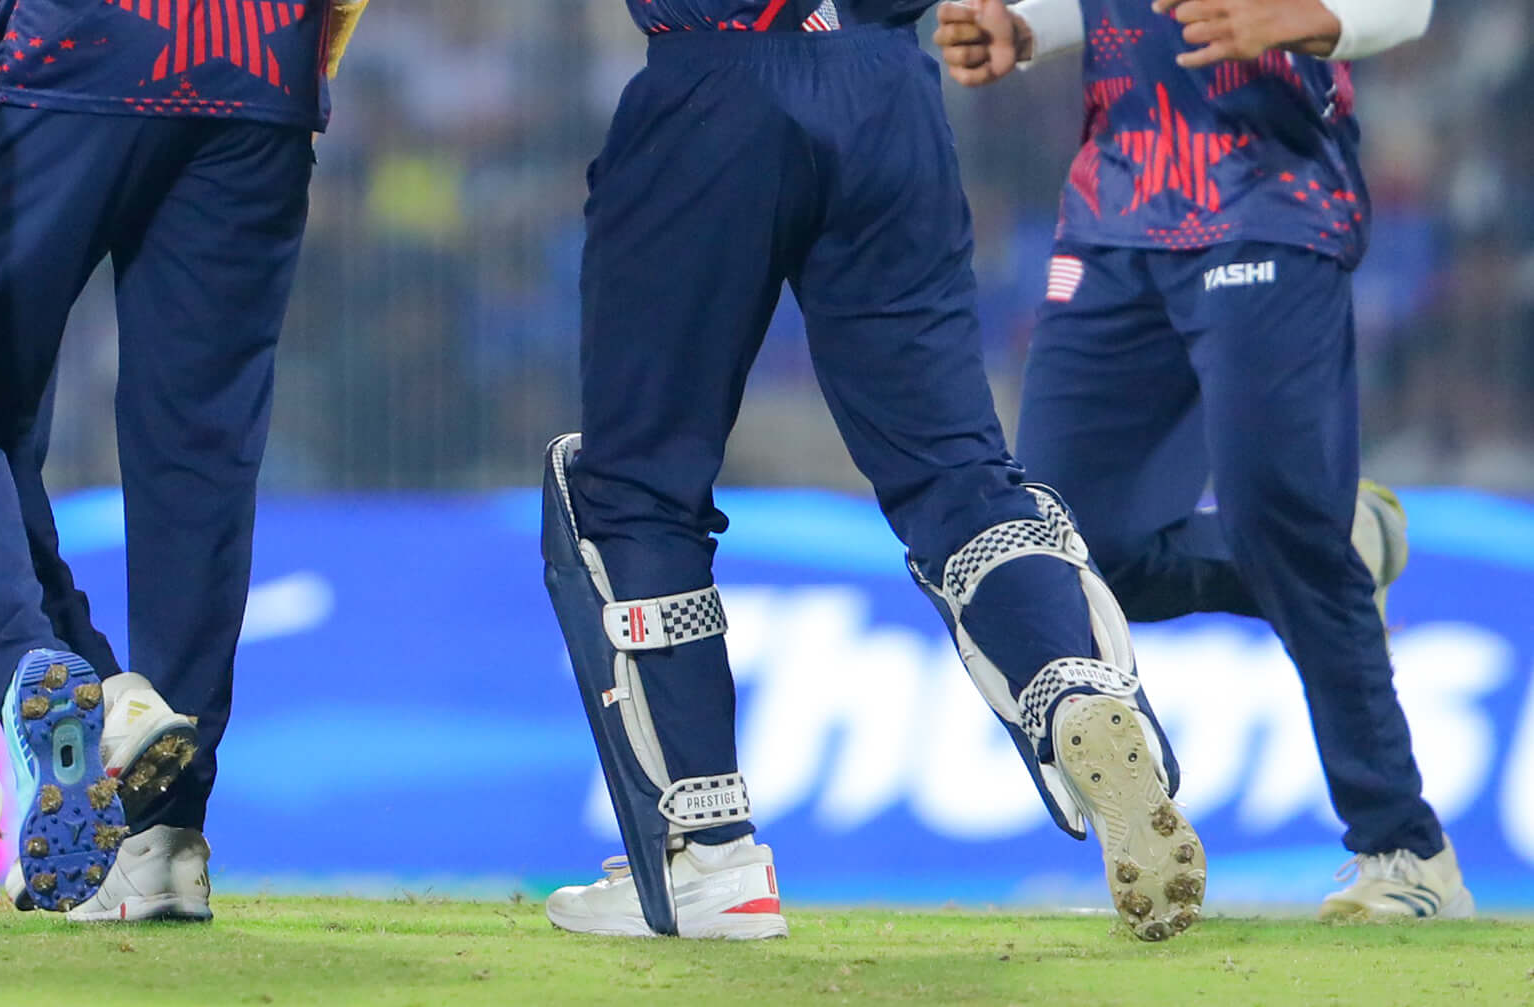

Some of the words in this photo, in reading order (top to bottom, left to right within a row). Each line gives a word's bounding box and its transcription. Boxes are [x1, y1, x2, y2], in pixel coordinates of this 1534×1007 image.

[1204, 260, 1275, 291] YASHI
[1068, 669, 1114, 684] PRESTIGE
[686, 791, 737, 809] PRESTIGE
